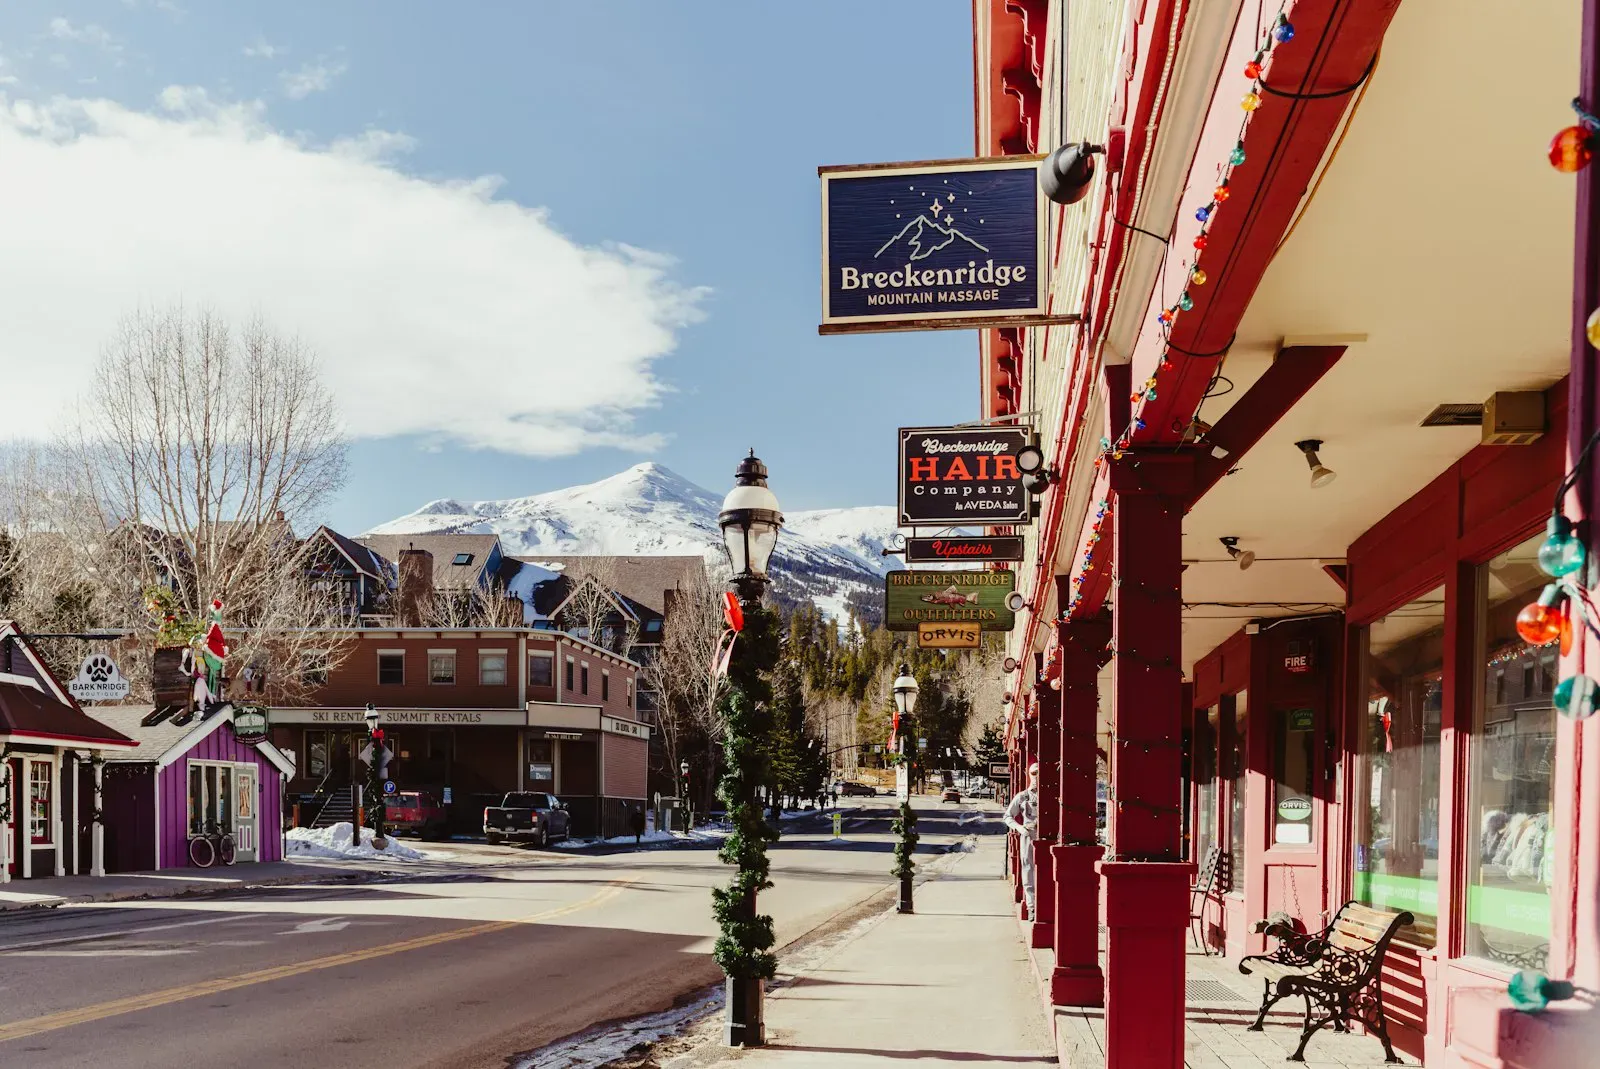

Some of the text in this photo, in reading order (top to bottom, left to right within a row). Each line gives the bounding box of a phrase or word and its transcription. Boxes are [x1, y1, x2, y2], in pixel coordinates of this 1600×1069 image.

[841, 259, 1026, 290] Breckenridge
[868, 289, 999, 306] MOUNTAIN MASSAGE
[922, 438, 1009, 455] Breckenridge
[909, 455, 1021, 482] HAIR
[914, 485, 1016, 496] Company
[964, 501, 1002, 510] AVEDA
[932, 540, 993, 559] Upstairs
[892, 574, 1009, 586] BRECKENRIDGE
[903, 609, 996, 620] OUTFITTERS
[922, 628, 976, 642] ORVIS
[1284, 655, 1307, 668] FIRE
[312, 712, 481, 723] SKI RENTA SUMMIT RENTALS
